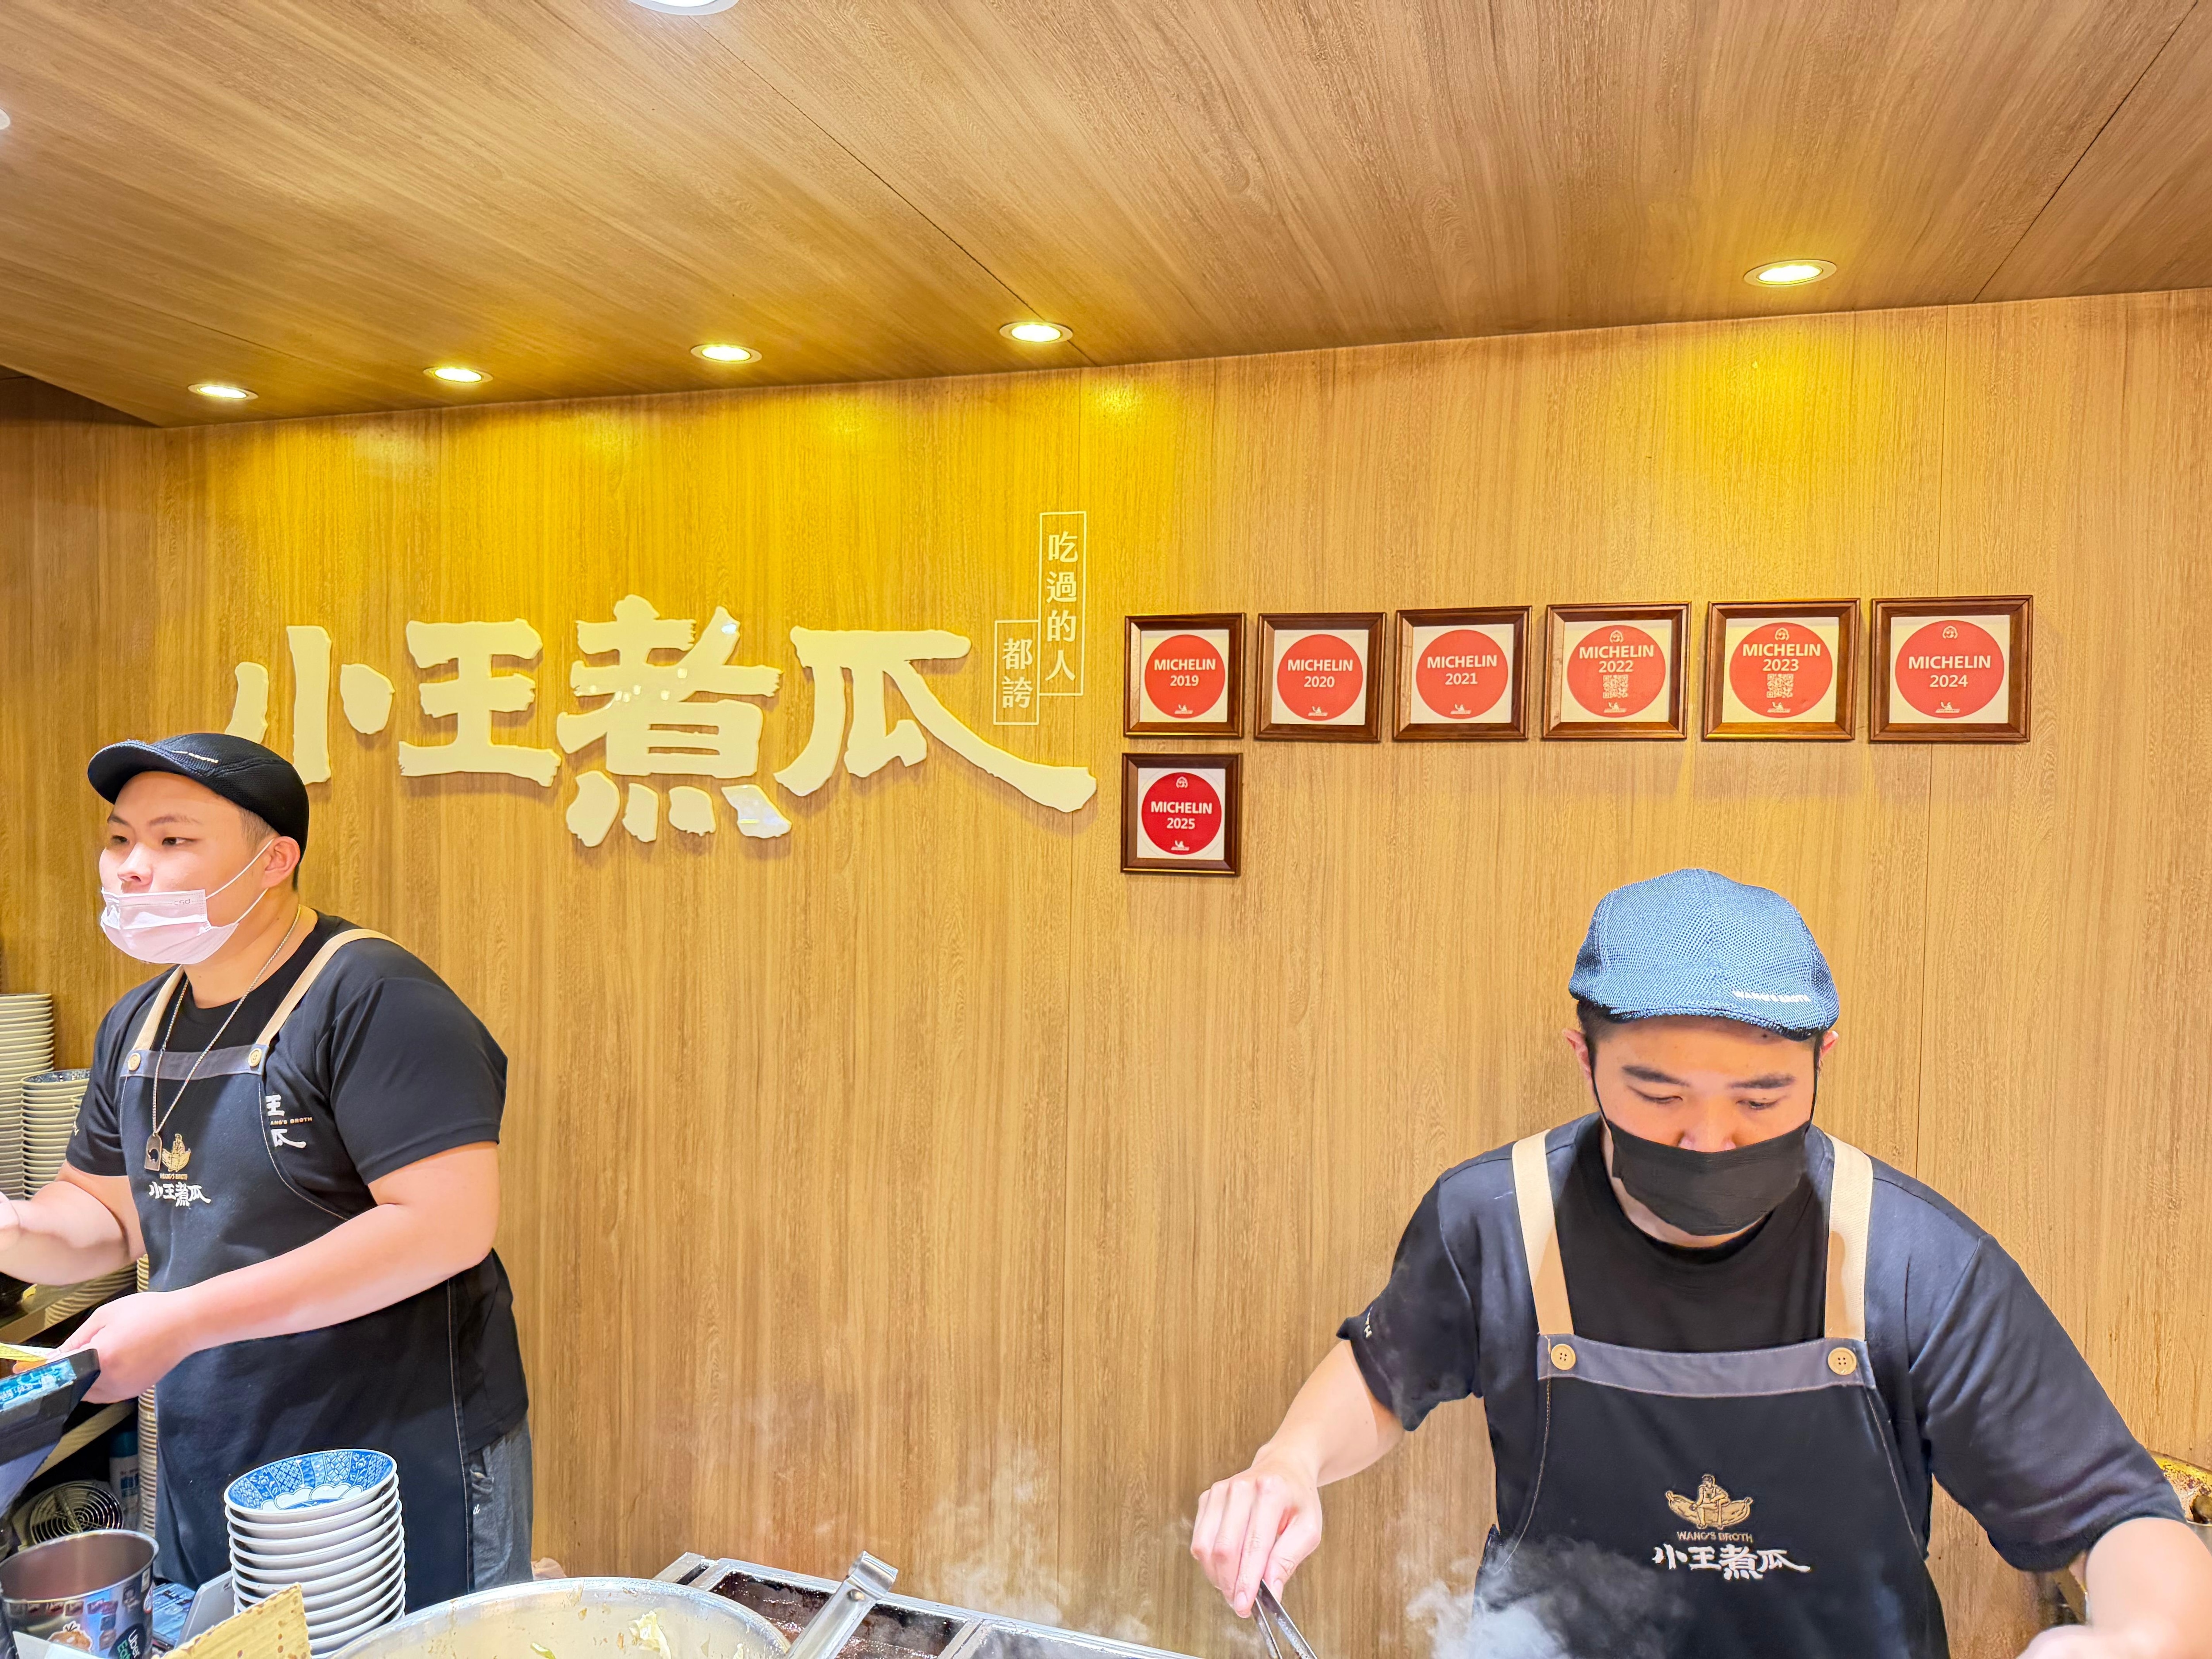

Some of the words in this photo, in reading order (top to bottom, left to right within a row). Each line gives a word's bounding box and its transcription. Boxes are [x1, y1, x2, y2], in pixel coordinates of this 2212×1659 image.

[1045, 531, 1079, 683] 吃過的人
[1578, 645, 1654, 659] MICHELIN
[1742, 643, 1821, 658] MICHELIN
[1154, 658, 1216, 671] MICHELIN
[1287, 659, 1353, 672] MICHELIN
[1427, 655, 1498, 669] MICHELIN
[1598, 660, 1634, 673] 2022
[1762, 658, 1799, 672] 2023
[1907, 655, 1991, 669] MICHELIN
[1001, 637, 1033, 709] 都誇
[1444, 672, 1478, 685] 2021
[1170, 675, 1199, 687] 2019
[1303, 676, 1335, 688] 2020
[1929, 674, 1969, 688] 2024
[224, 594, 1098, 847] 小王煮瓜
[1151, 800, 1213, 815] MICHELIN
[1166, 817, 1196, 830] 2025
[149, 1181, 211, 1207] 小王煮瓜
[1676, 1531, 1717, 1541] WANG'S
[1718, 1532, 1753, 1544] BROTH
[1652, 1544, 1811, 1580] 小王煮瓜
[128, 1628, 141, 1659] Uber
